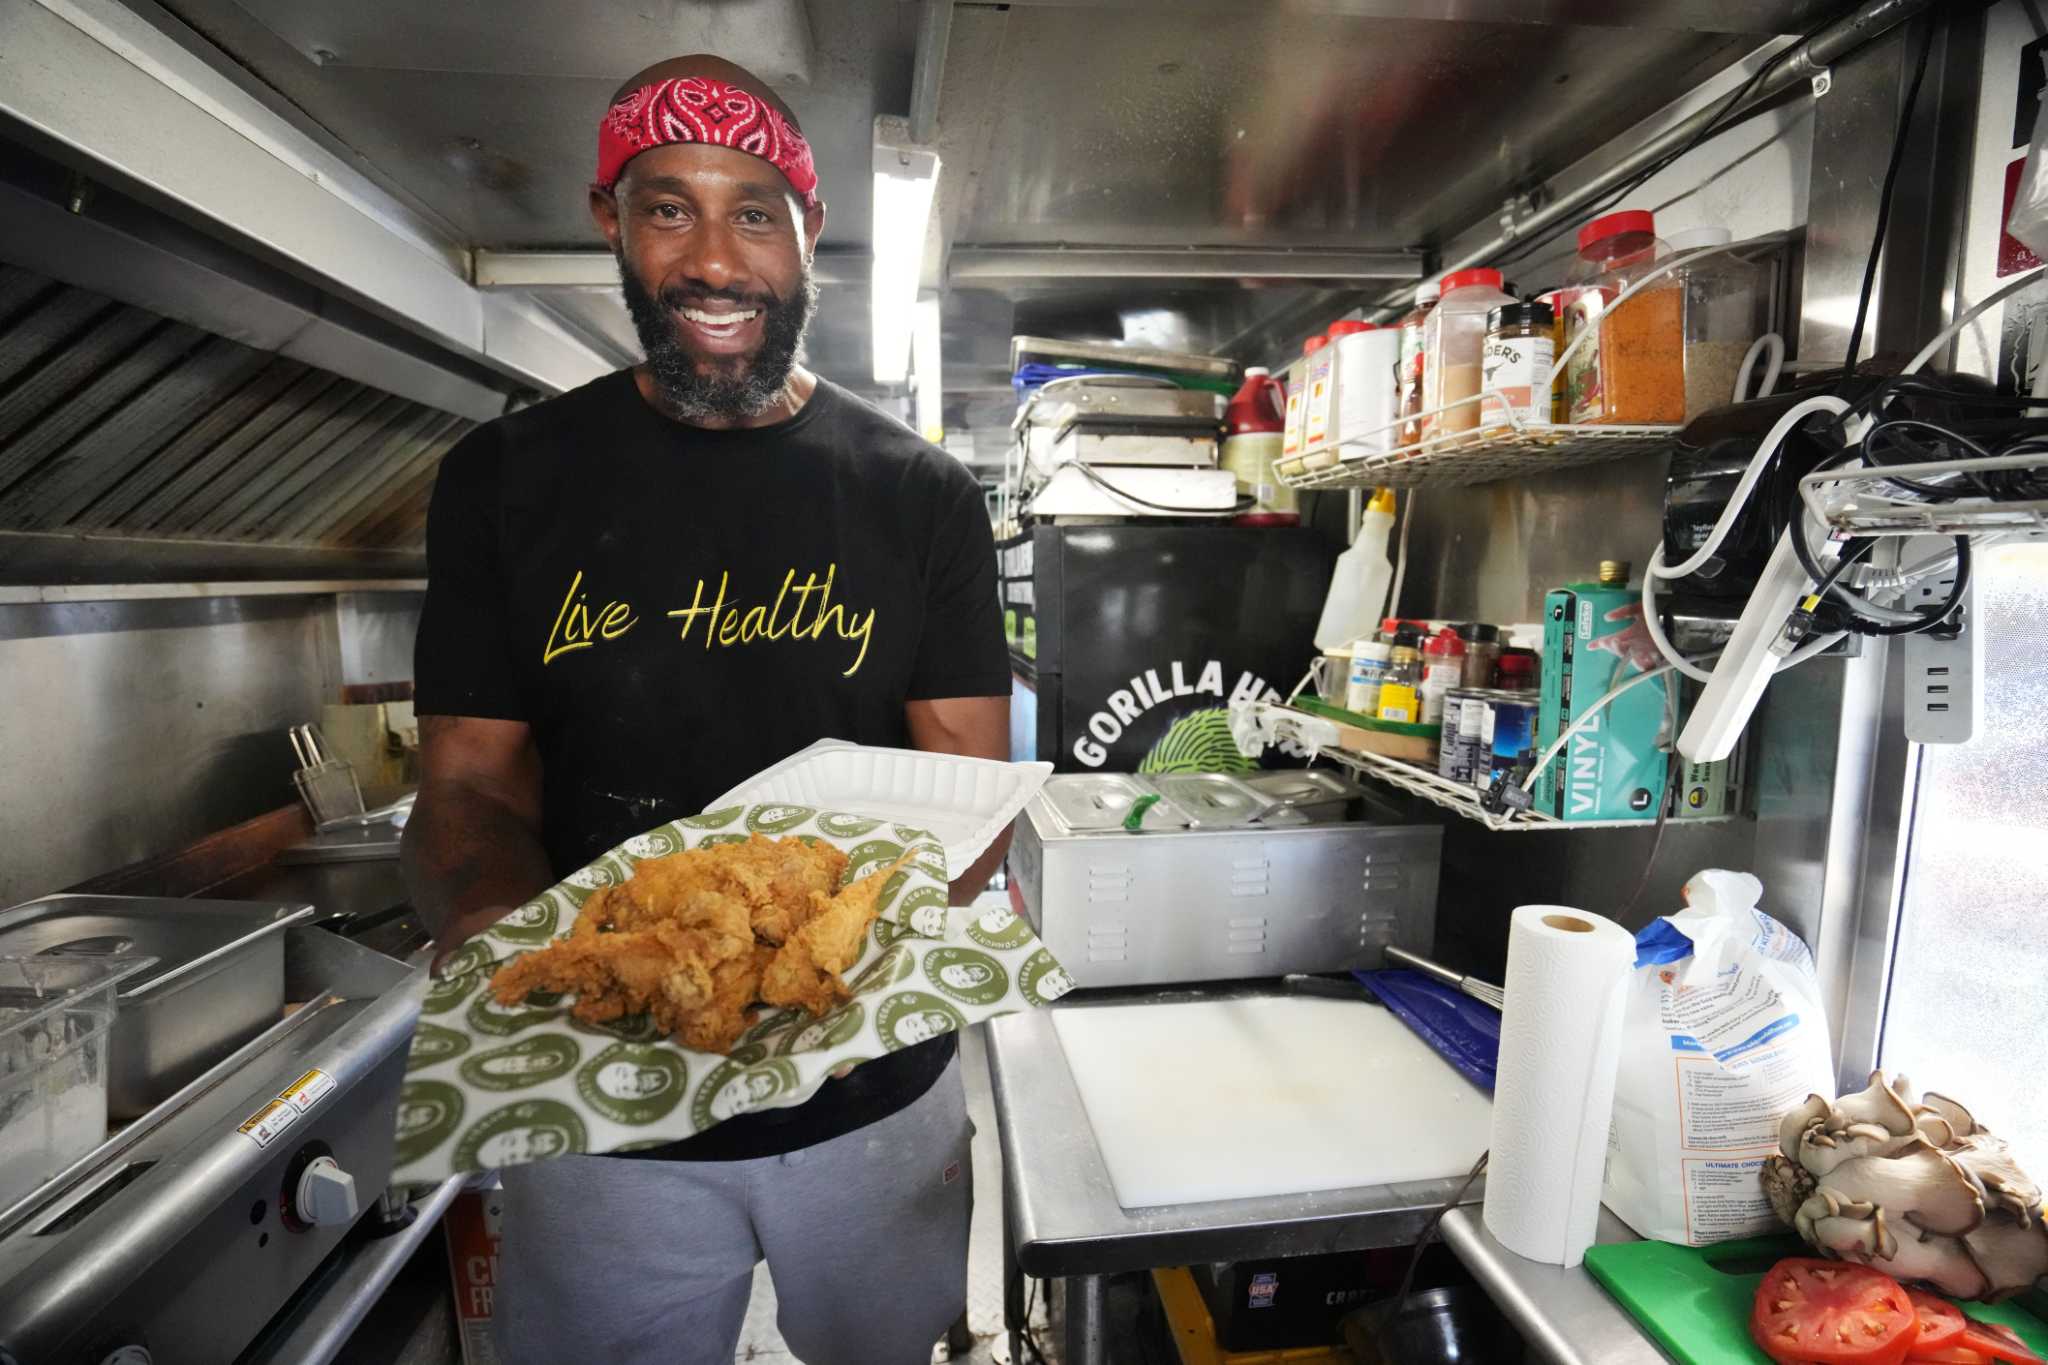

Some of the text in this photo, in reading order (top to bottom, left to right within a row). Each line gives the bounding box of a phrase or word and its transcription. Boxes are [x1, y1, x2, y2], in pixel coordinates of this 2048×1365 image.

[543, 563, 876, 677] Live Healthy
[1072, 659, 1224, 768] GORILLA
[1570, 714, 1600, 815] VINYL
[1251, 1284, 1274, 1297] USA
